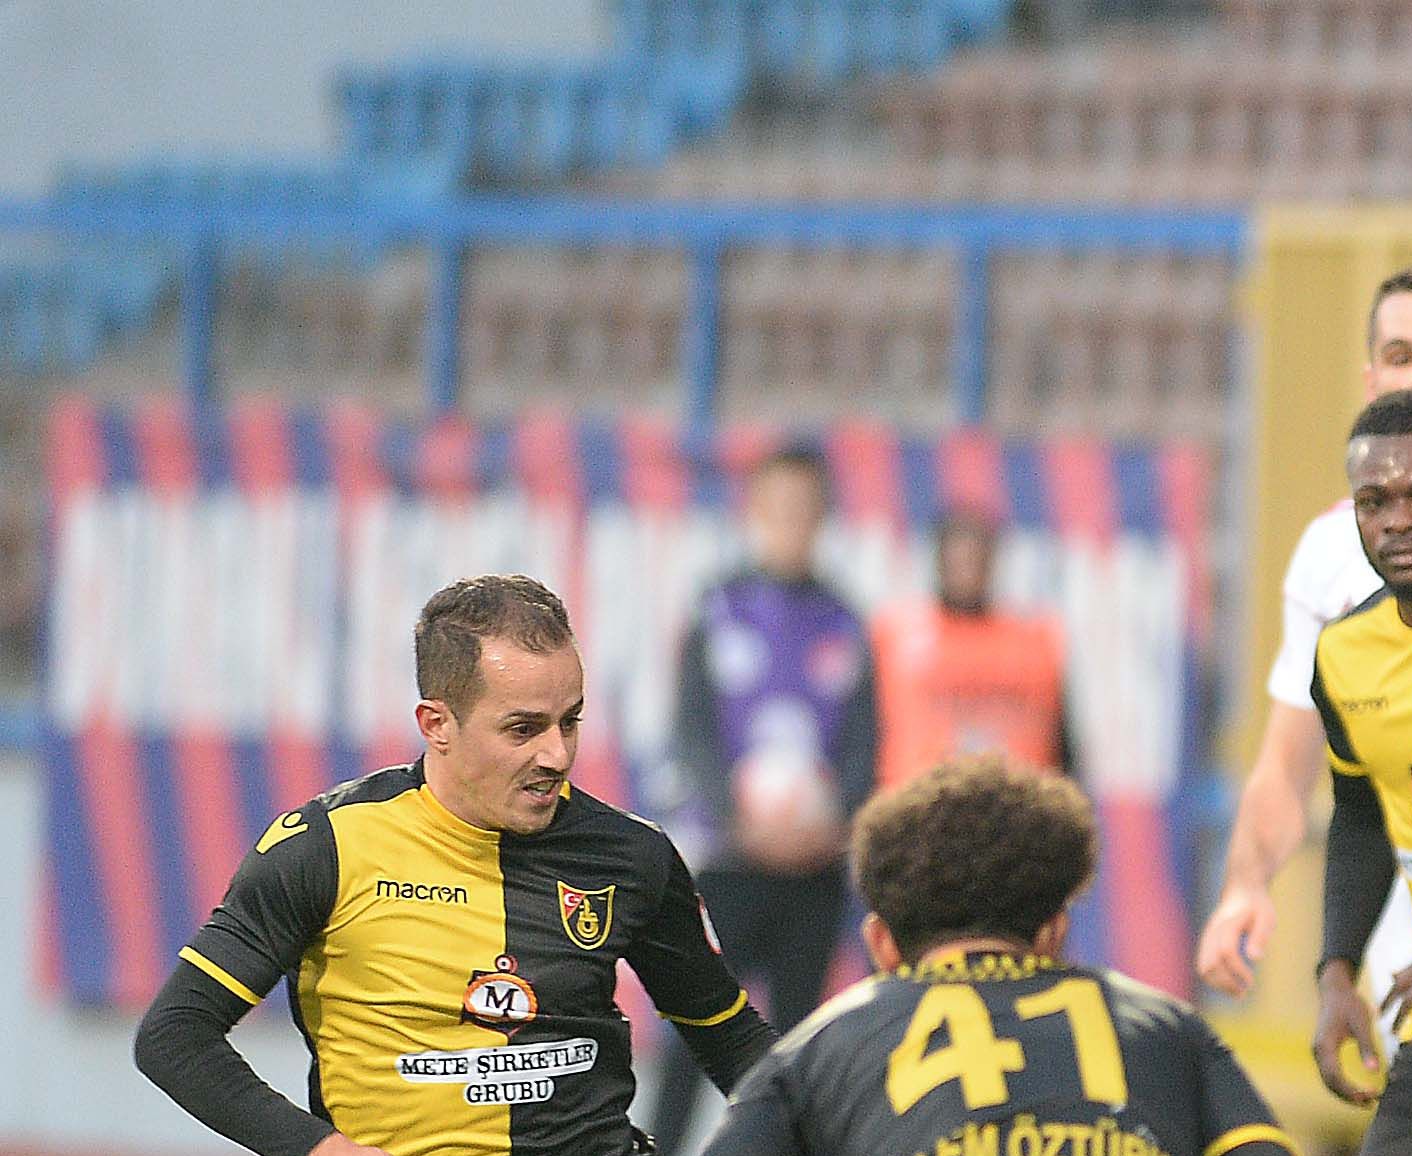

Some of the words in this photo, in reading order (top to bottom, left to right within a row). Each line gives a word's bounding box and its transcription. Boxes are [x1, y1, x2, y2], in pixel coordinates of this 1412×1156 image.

[376, 879, 468, 904] macron
[400, 1056, 469, 1076] METE
[477, 1043, 594, 1079] ŞİRKETLER
[886, 977, 1129, 1116] 41
[466, 1079, 550, 1104] GRUBU
